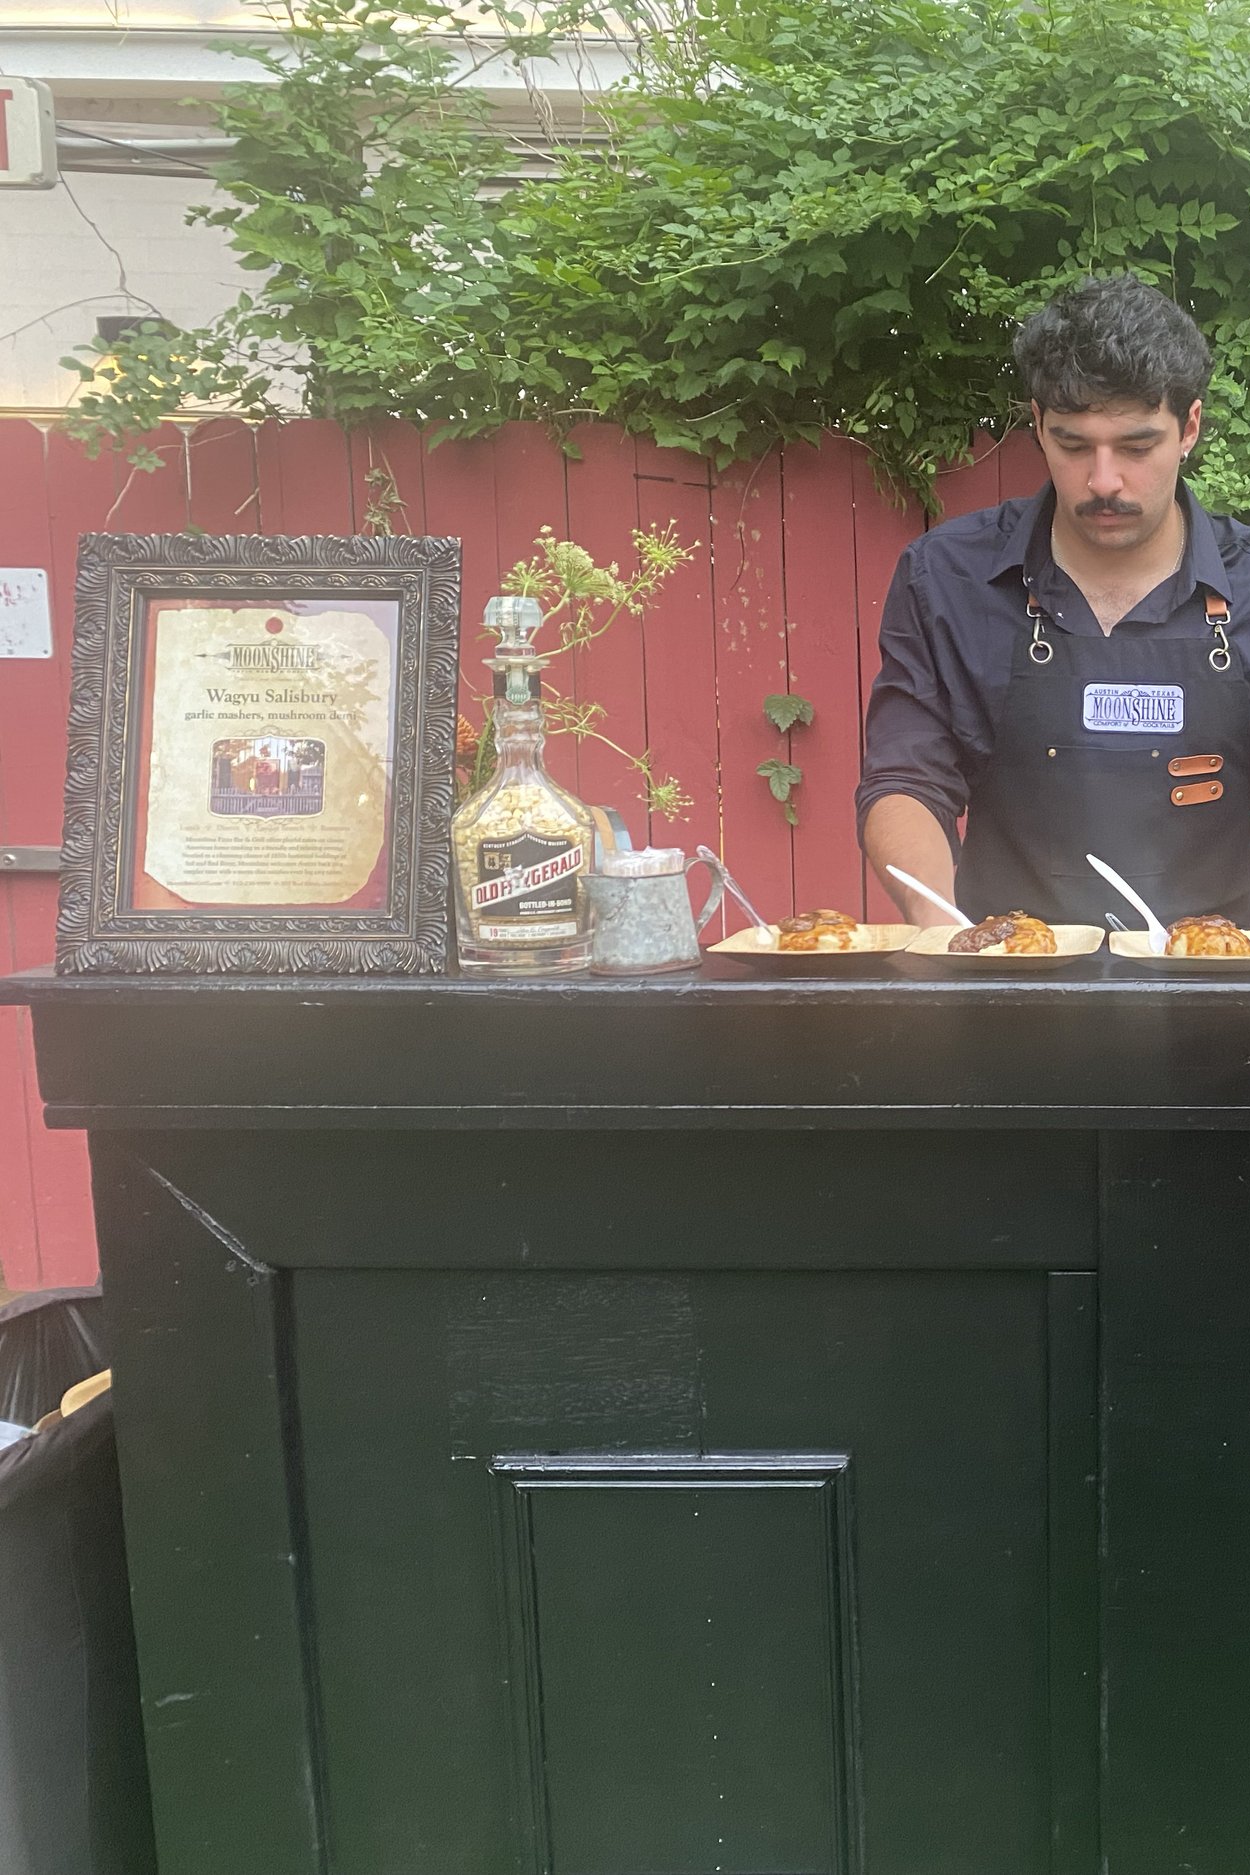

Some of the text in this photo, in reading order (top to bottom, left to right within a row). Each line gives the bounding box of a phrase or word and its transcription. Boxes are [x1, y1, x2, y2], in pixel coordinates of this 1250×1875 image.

[232, 646, 315, 672] MOONSHINE
[206, 688, 337, 705] Wagyu Salisbury
[185, 709, 357, 721] garlic mashers, mushroom demi
[1092, 696, 1176, 726] MOONSHINE
[476, 882, 499, 904] OLD
